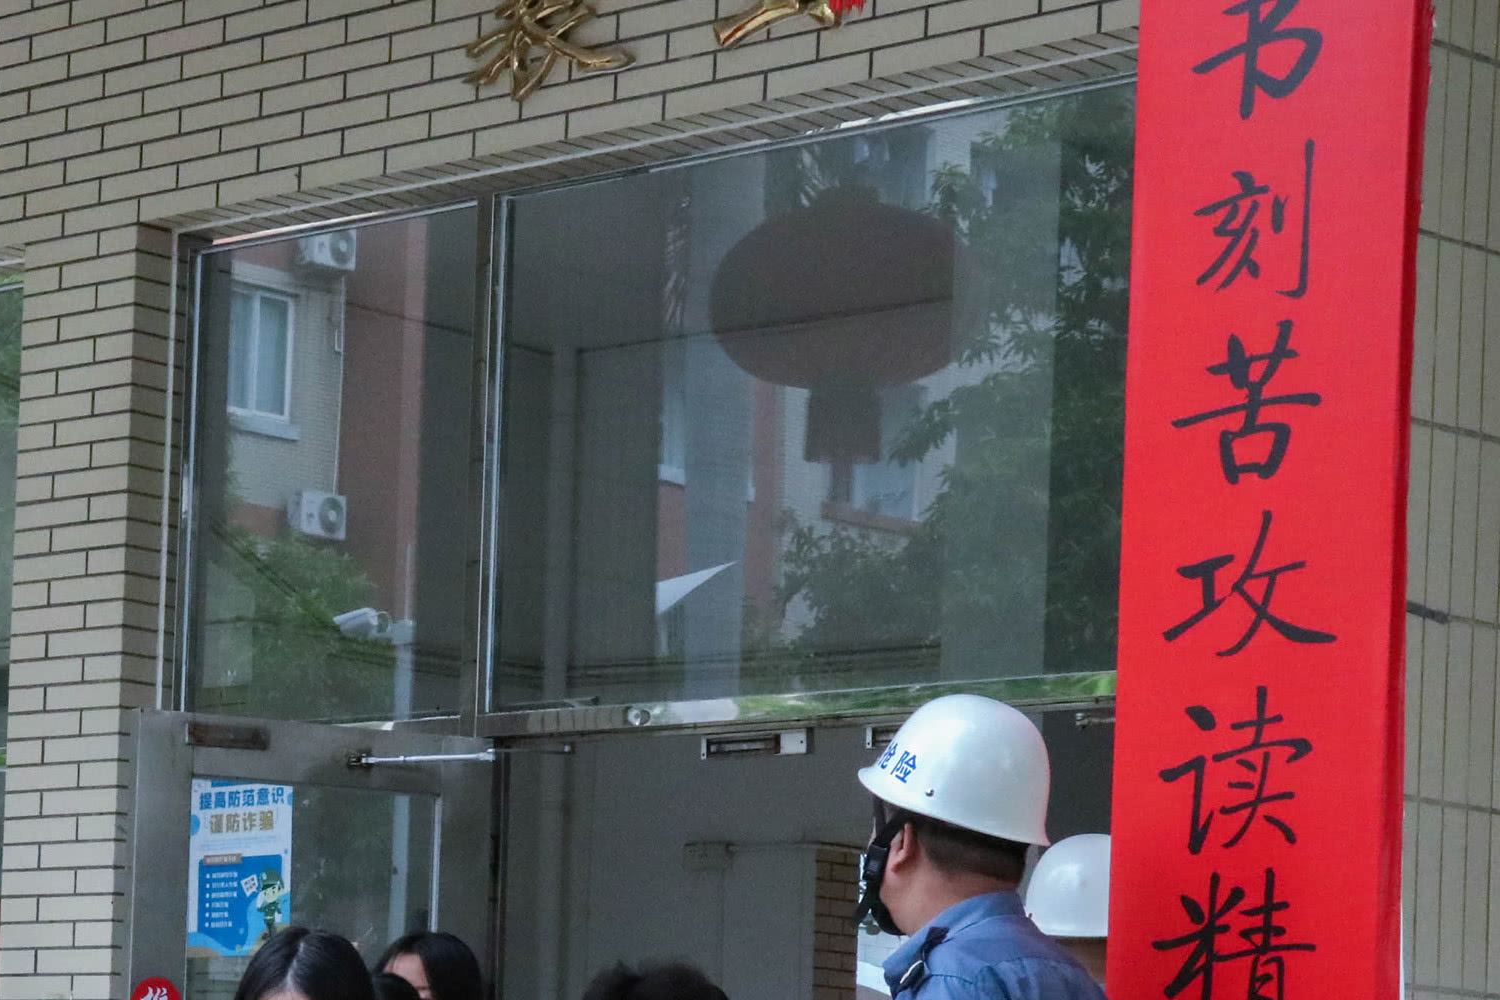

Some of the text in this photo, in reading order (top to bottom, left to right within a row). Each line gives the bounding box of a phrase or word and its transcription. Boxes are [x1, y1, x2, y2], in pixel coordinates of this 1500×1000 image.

[200, 787, 284, 810] 提高防范意识
[211, 810, 274, 833] 谨防诈骗
